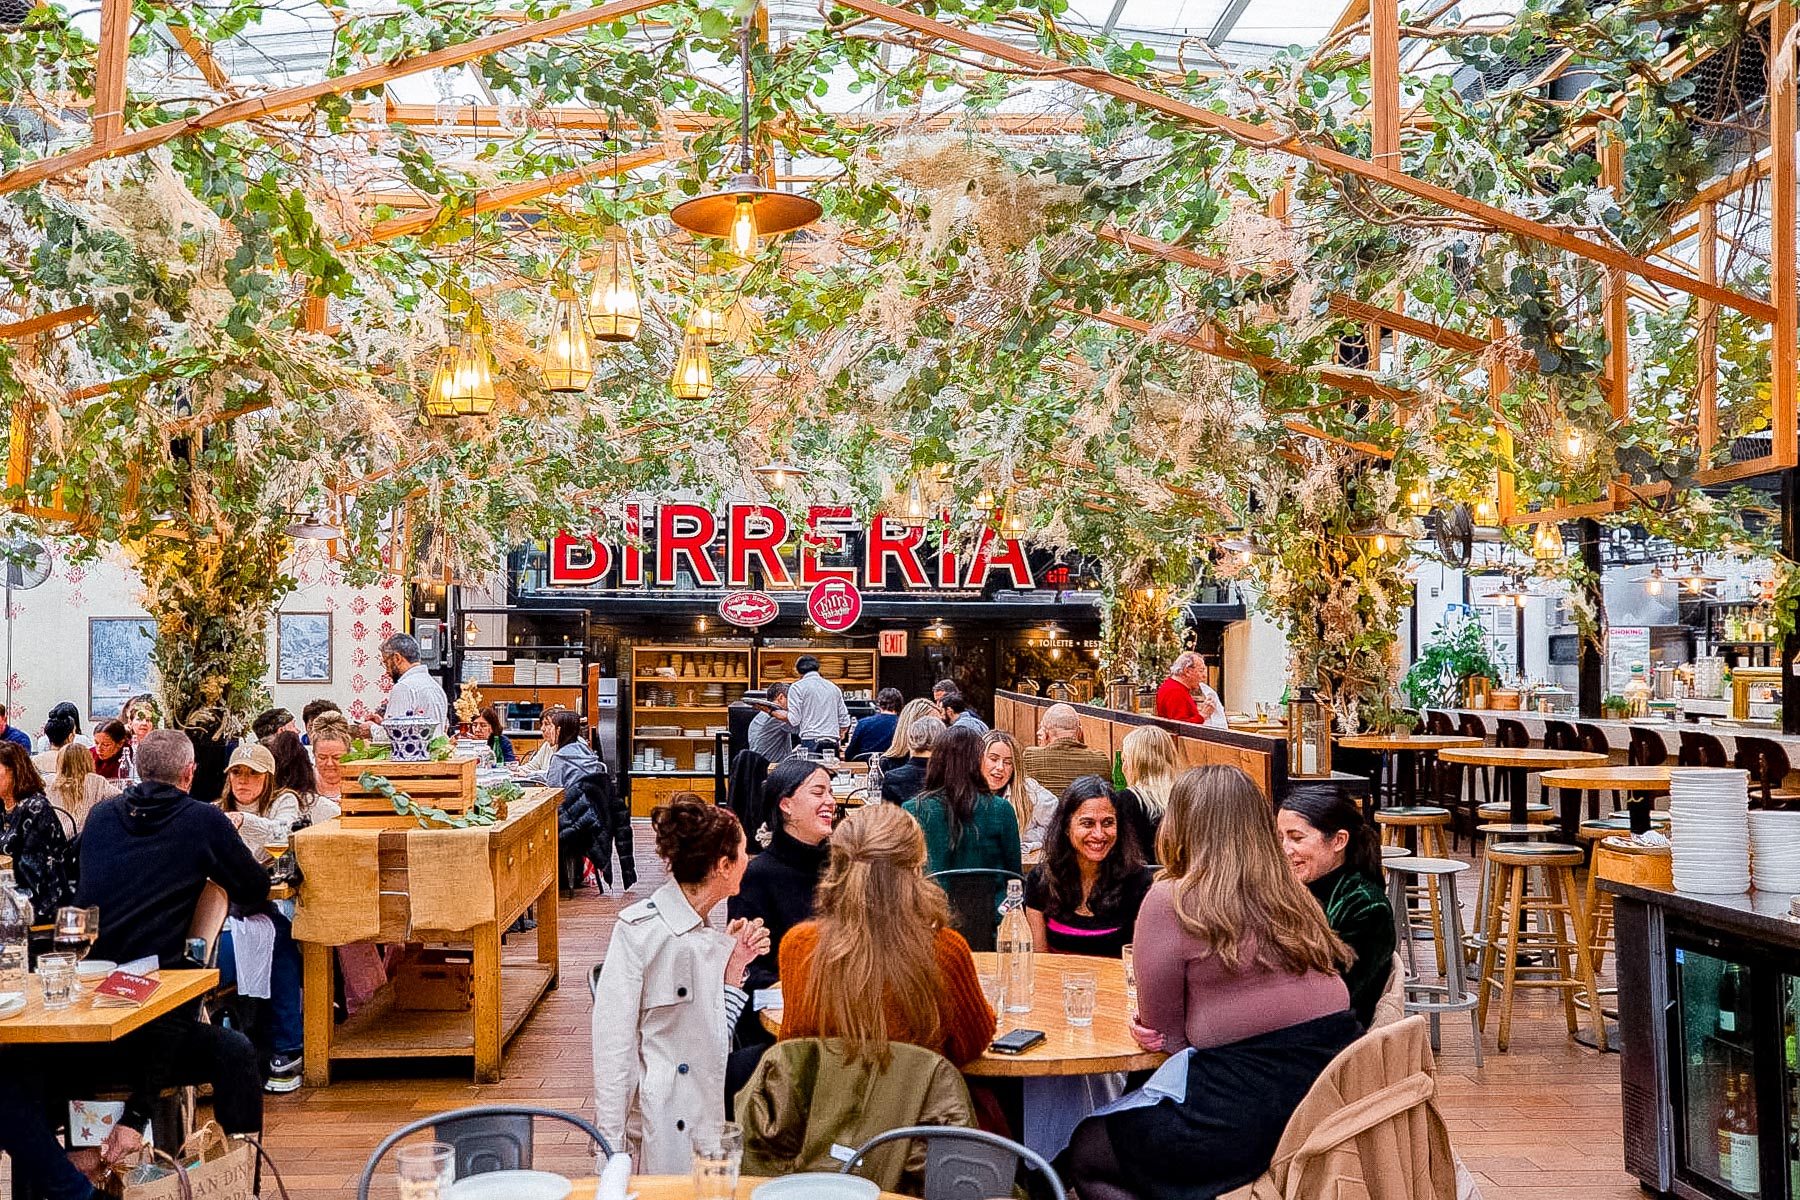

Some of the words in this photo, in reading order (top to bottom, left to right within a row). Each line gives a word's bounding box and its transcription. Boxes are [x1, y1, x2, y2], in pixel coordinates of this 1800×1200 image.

[548, 501, 1036, 589] BIRRERIA
[884, 633, 904, 653] EXIT
[1039, 639, 1074, 648] TOILETTE
